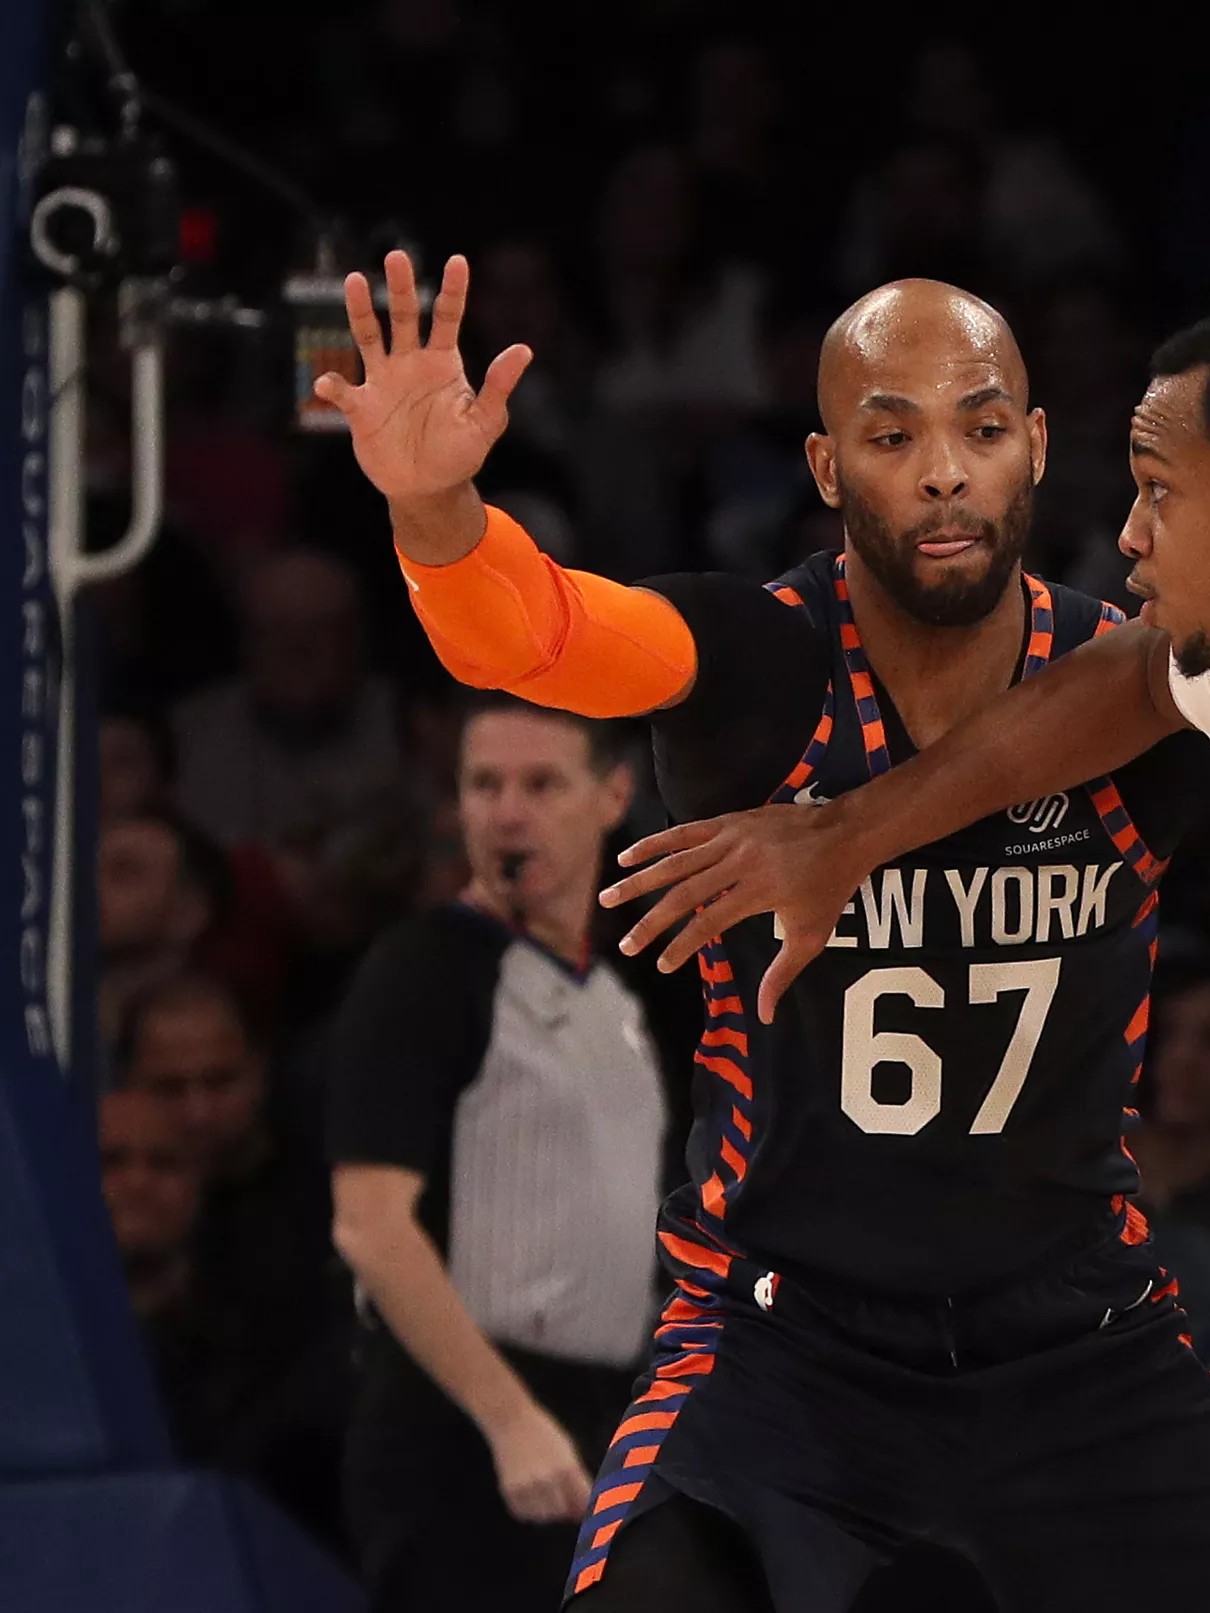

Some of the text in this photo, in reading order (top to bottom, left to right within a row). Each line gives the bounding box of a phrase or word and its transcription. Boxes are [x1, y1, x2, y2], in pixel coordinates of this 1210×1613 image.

[1004, 829, 1090, 856] SQUARESPACE
[773, 861, 1124, 950] EW YORK
[840, 956, 1063, 1137] 67
